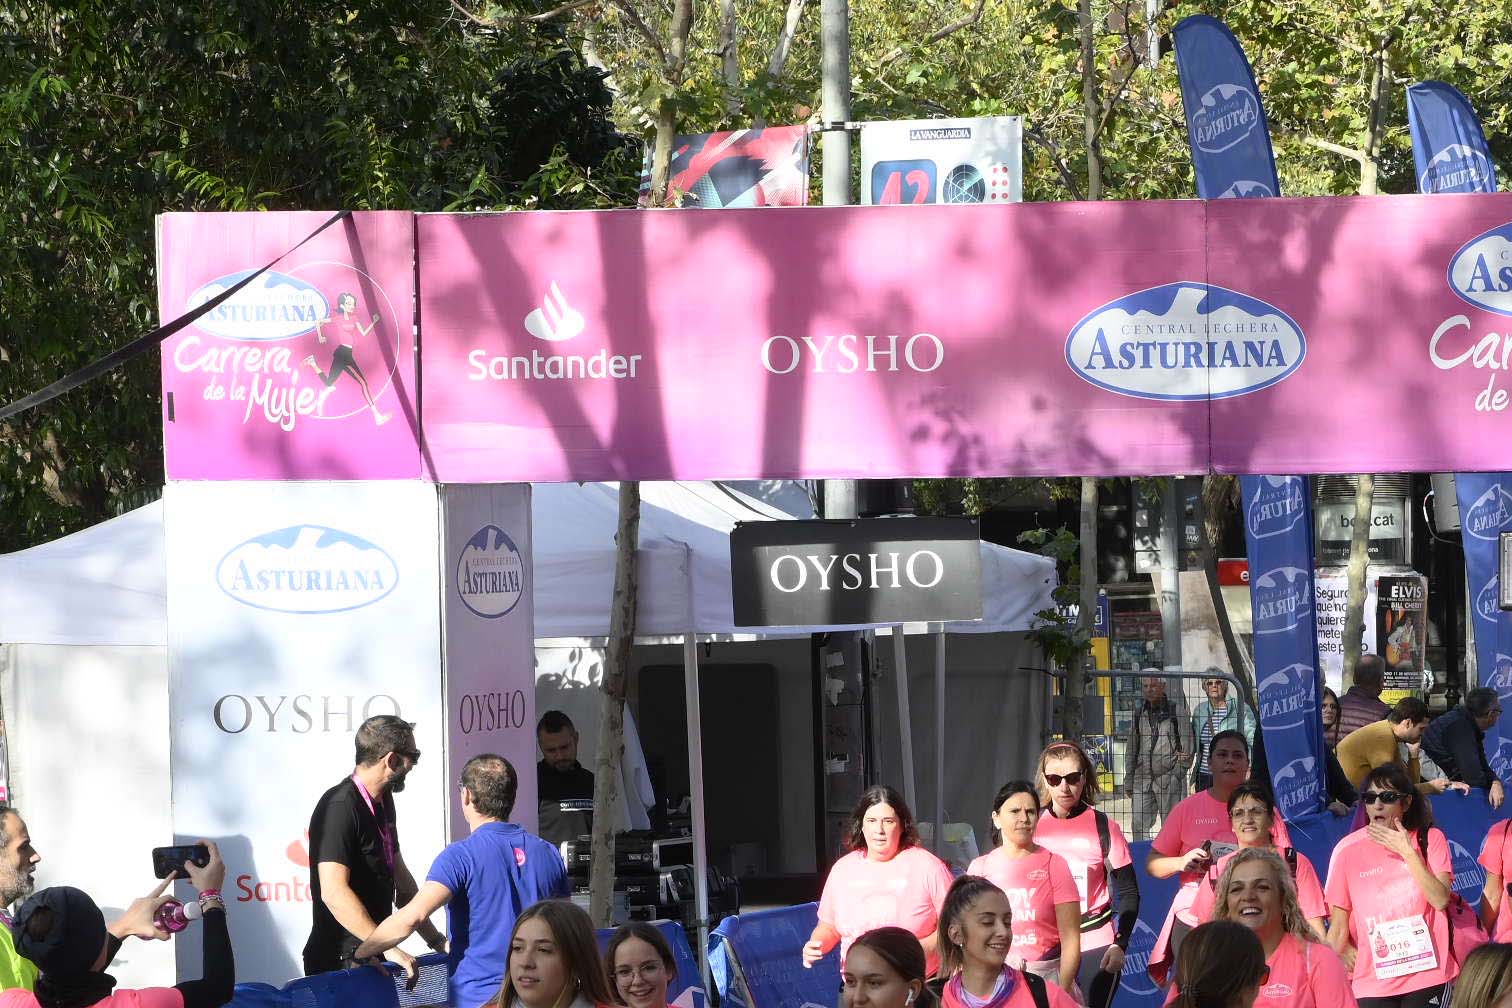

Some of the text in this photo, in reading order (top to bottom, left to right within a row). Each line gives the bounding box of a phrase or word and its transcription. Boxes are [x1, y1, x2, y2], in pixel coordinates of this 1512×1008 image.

[1121, 322, 1279, 337] CENTRAL LECHERA
[174, 335, 292, 373] Carrera
[469, 347, 641, 382] Santander
[761, 333, 945, 374] OYSHO
[1084, 327, 1288, 370] ASTURIANA
[203, 369, 336, 432] de la Mujer
[1475, 374, 1509, 412] de
[231, 559, 385, 592] ASTURIANA
[462, 560, 520, 595] ASTURIANA
[770, 550, 944, 593] OYSHO
[1317, 603, 1334, 614] que
[1391, 586, 1422, 598] ELVIS
[1318, 642, 1337, 652] este
[459, 690, 526, 735] OYSHO
[1390, 940, 1411, 952] 016
